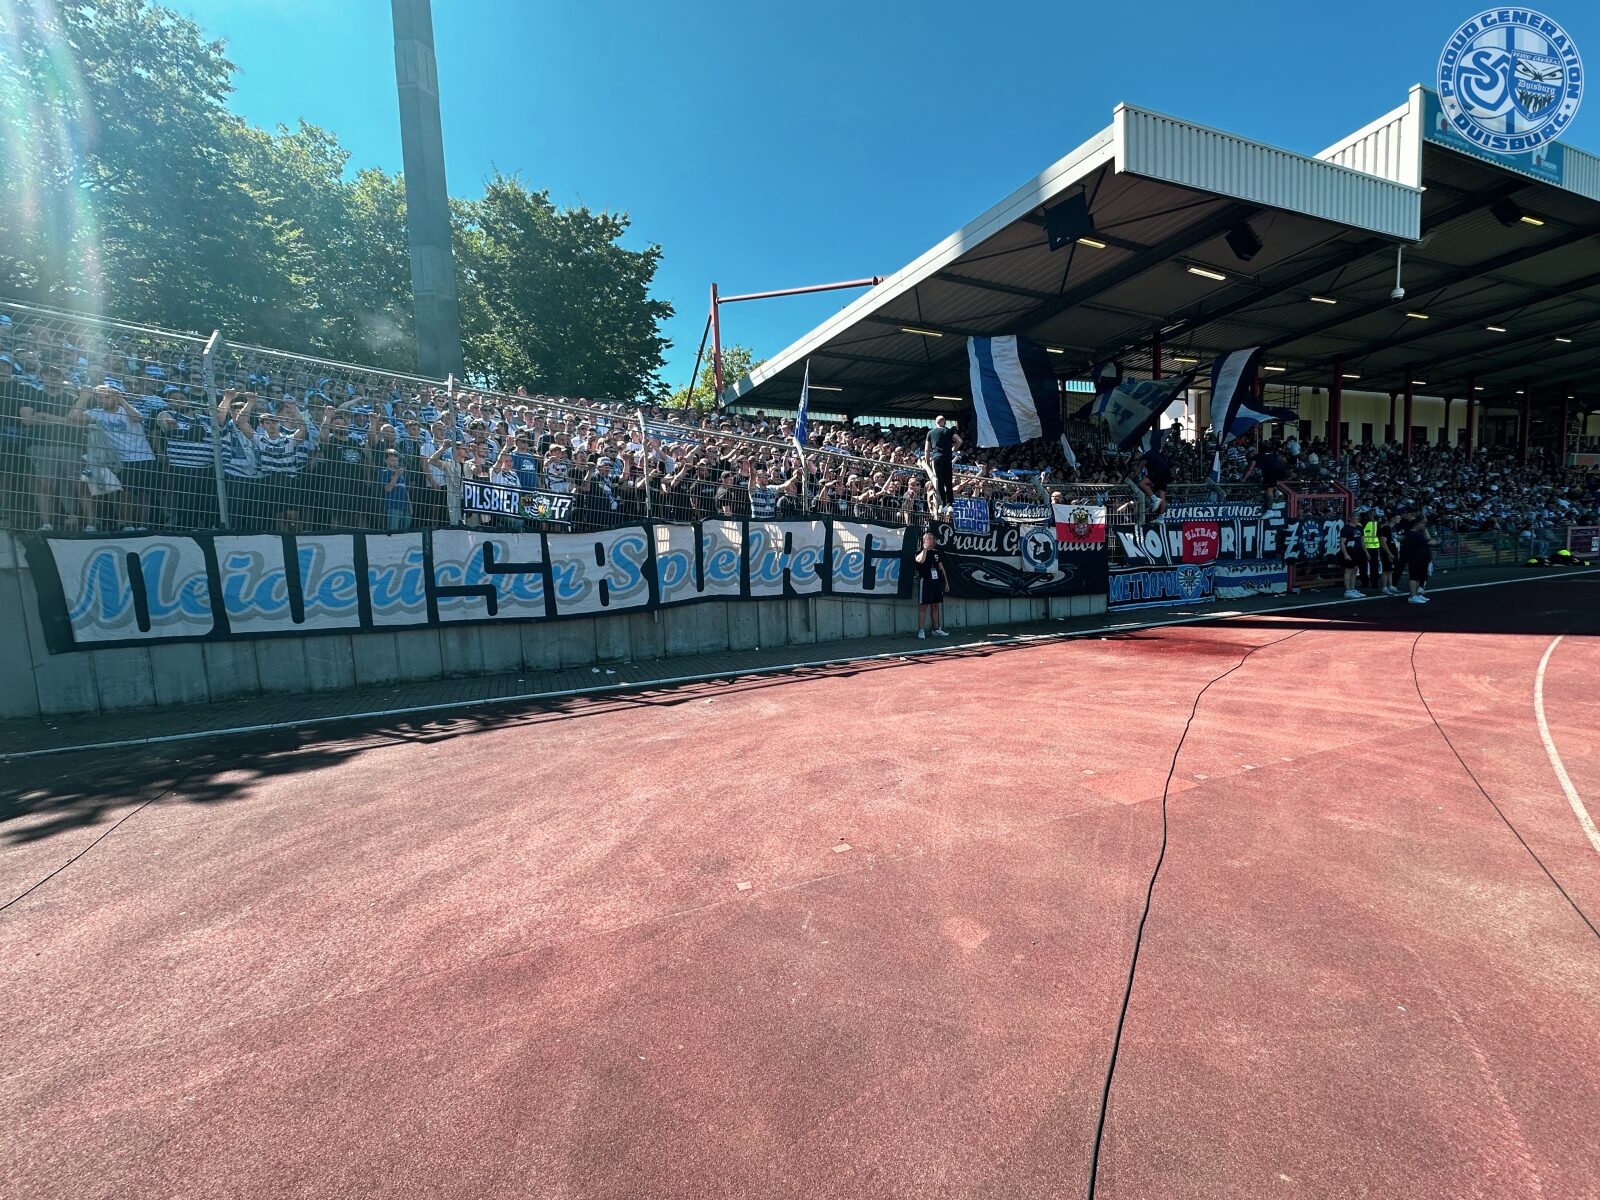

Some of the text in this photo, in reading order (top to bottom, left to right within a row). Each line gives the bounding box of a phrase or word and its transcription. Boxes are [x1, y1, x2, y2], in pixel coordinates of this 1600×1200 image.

[464, 484, 572, 520] PILSBIER 47
[936, 523, 998, 553] Proud
[1117, 524, 1277, 558] KOHRTE
[1184, 527, 1218, 541] ULTRAS
[1192, 541, 1208, 556] MZ
[47, 520, 906, 642] DUISBURG
[605, 530, 900, 601] Spielverein
[67, 542, 588, 628] Meidericher
